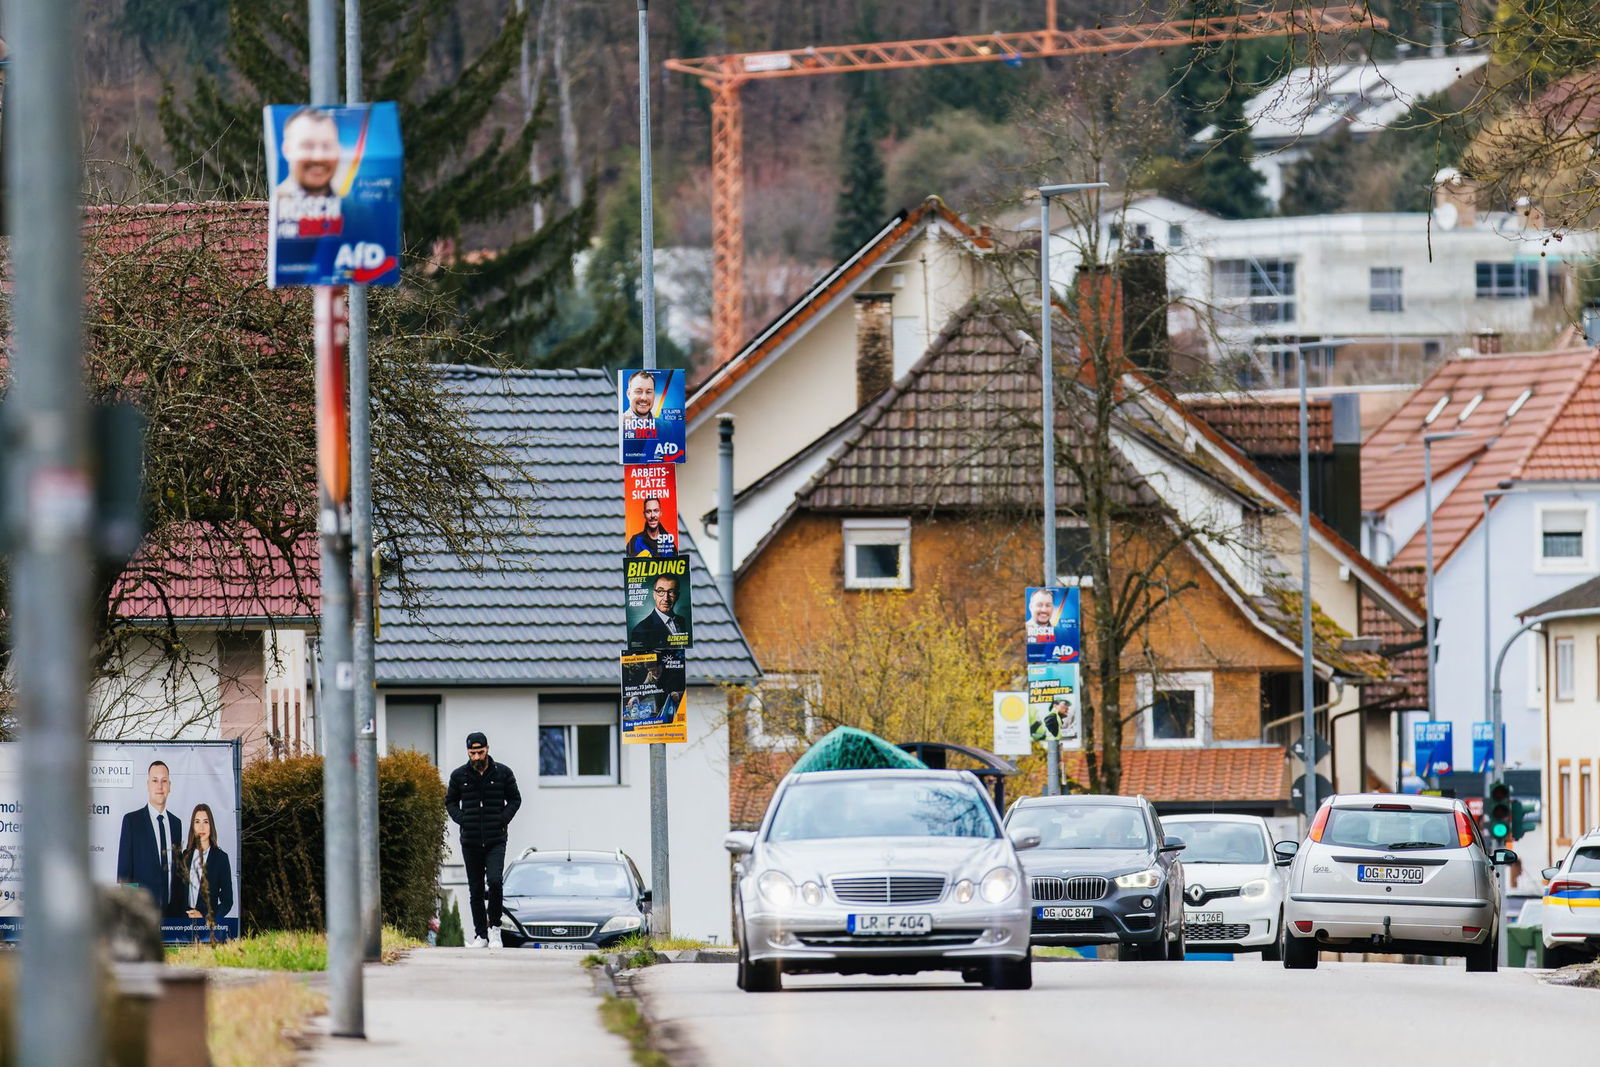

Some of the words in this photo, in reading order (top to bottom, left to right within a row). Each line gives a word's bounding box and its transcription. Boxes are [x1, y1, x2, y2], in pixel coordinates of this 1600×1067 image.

[335, 241, 386, 270] AfD
[625, 415, 656, 430] RÖSCH
[625, 431, 635, 439] FÜR
[635, 428, 657, 438] DICH
[654, 442, 679, 455] AfD
[631, 467, 669, 478] ARBEITS-
[635, 477, 666, 488] PLÄTZE
[632, 488, 669, 500] SICHERN
[657, 533, 674, 544] SPD
[627, 560, 687, 577] BILDUNG
[1052, 645, 1074, 656] AfD
[1030, 687, 1042, 695] FÜR
[1030, 695, 1053, 703] PLÄTZE
[91, 767, 105, 775] ON
[108, 767, 131, 775] POLL
[1365, 869, 1379, 878] OG
[1385, 869, 1399, 879] RJ
[1402, 869, 1421, 880] 900
[1043, 908, 1056, 917] OG
[1061, 908, 1073, 918] OC
[1075, 908, 1092, 917] 847
[1195, 913, 1201, 922] K
[1201, 913, 1221, 922] 126E
[860, 916, 878, 929] LR
[888, 917, 895, 928] F
[899, 916, 924, 929] 404
